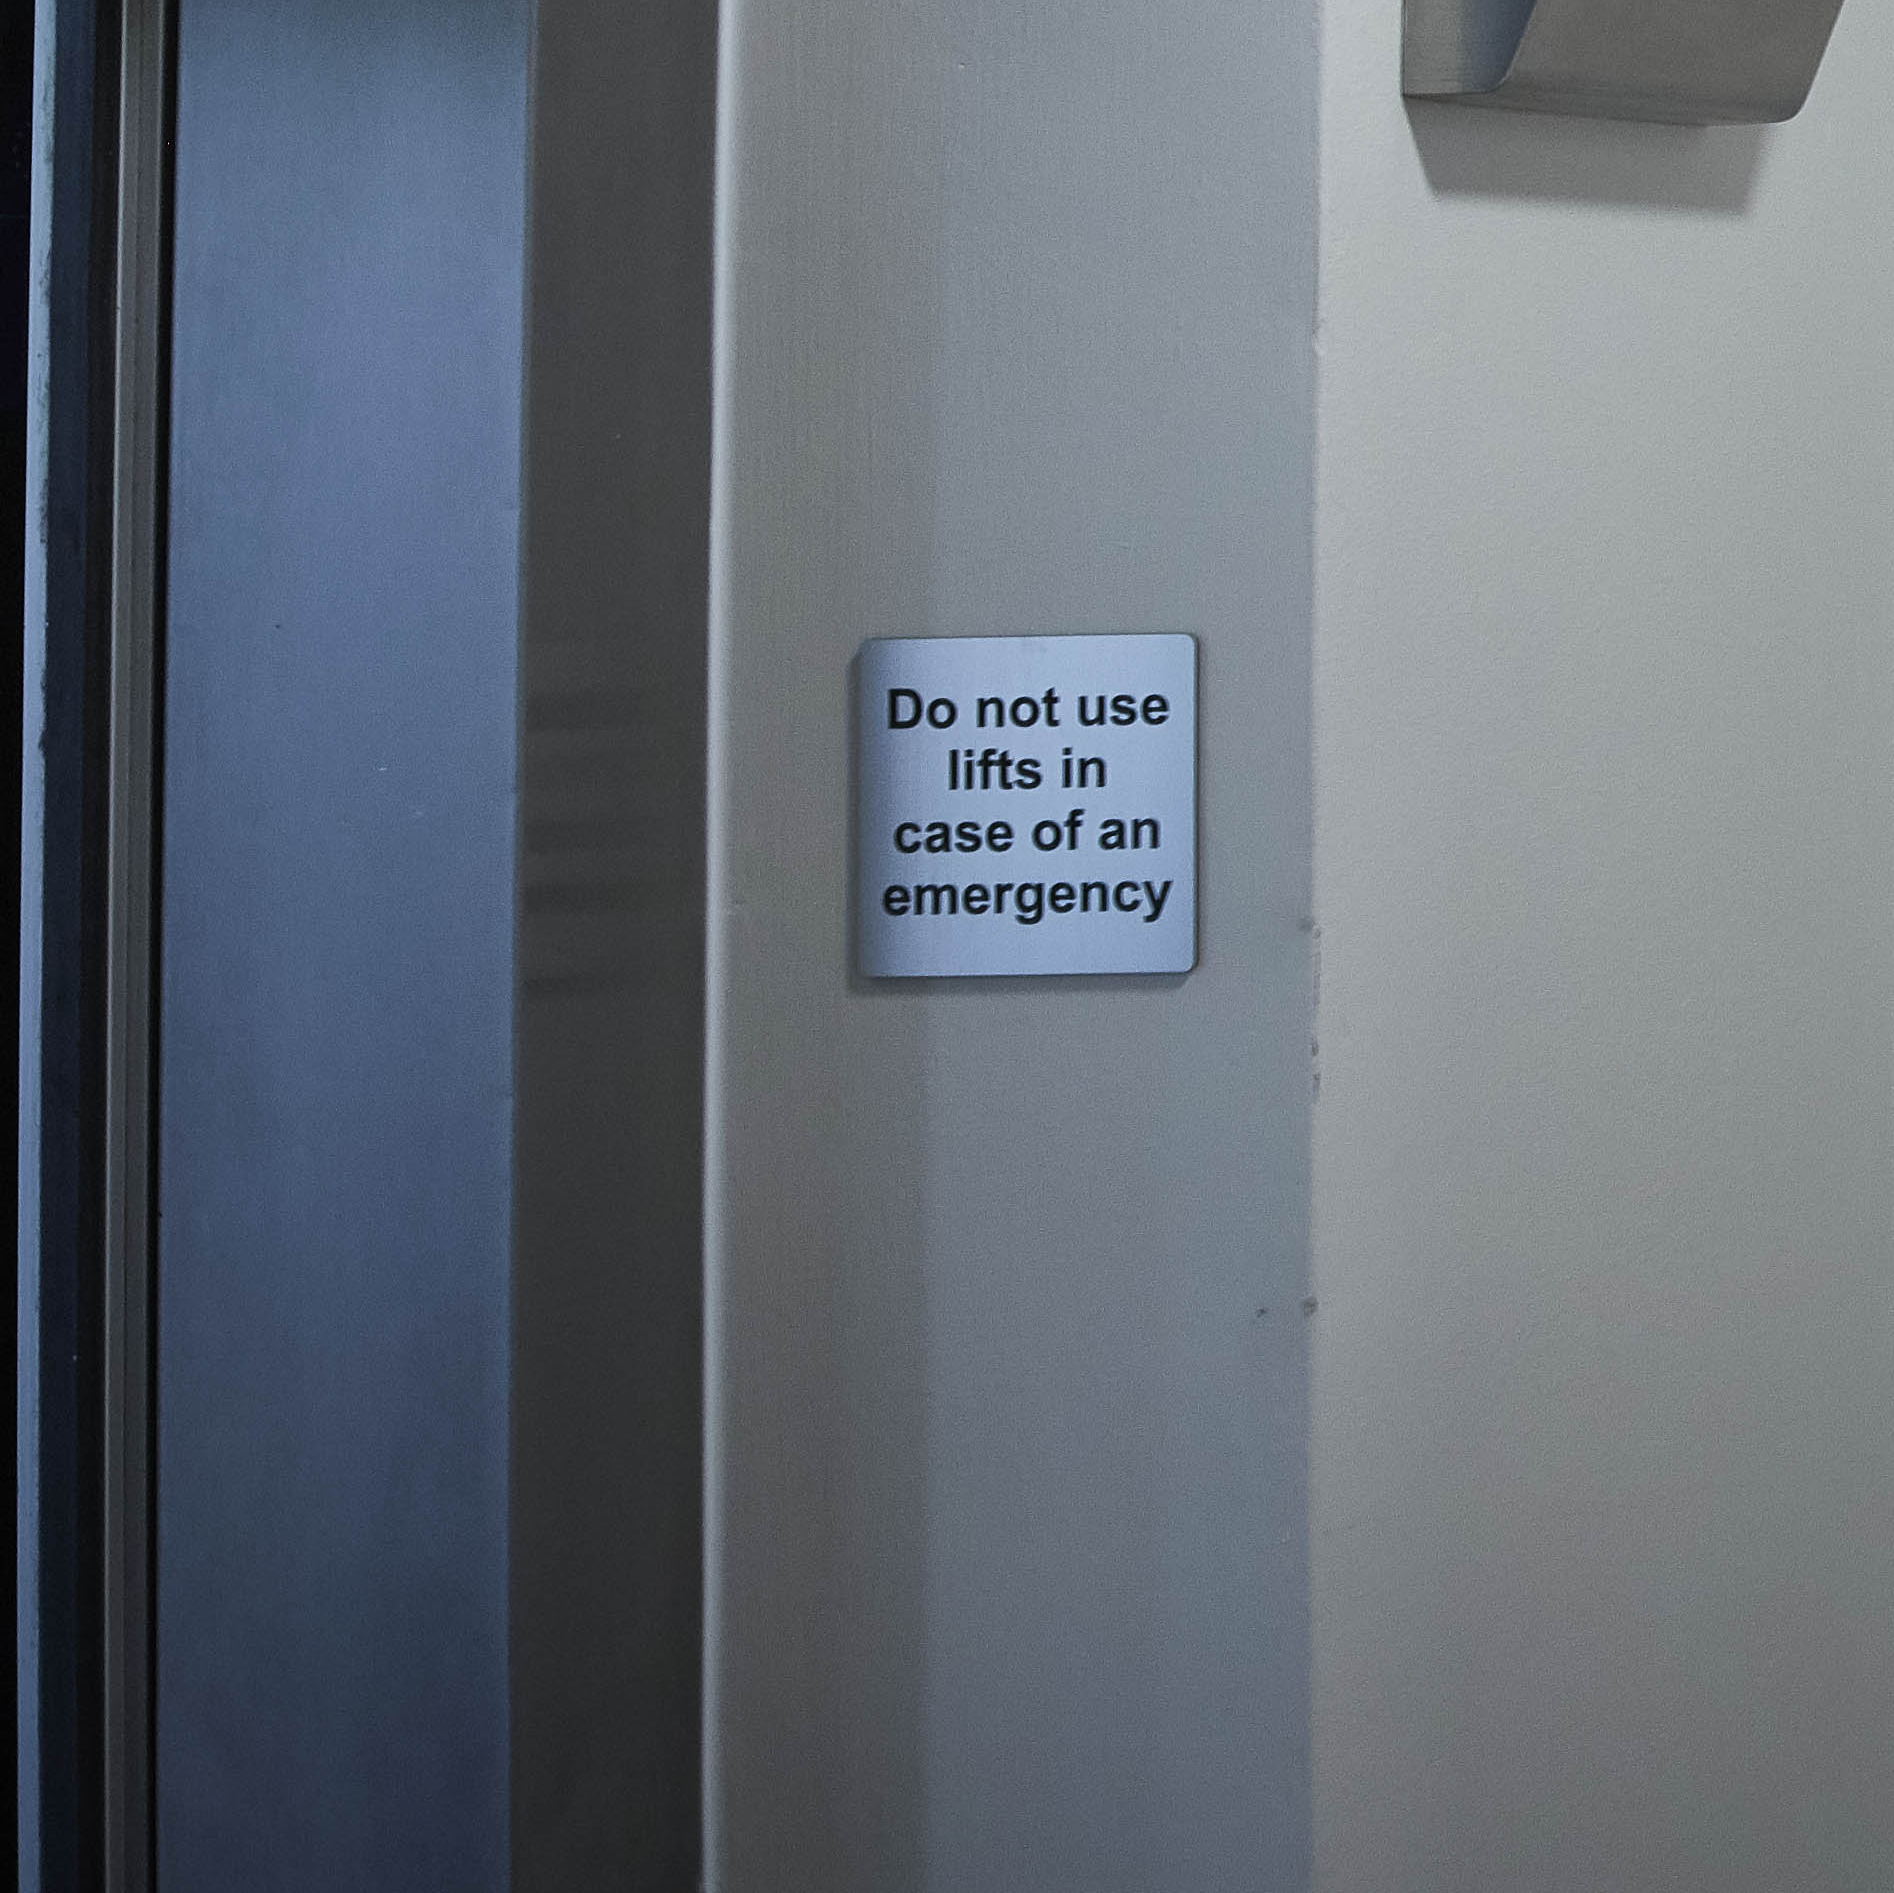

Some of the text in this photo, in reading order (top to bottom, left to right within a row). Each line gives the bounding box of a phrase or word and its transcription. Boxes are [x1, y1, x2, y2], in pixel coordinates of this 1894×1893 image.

[886, 687, 1170, 730] Do not use
[947, 747, 1107, 790] lifts in
[893, 808, 1161, 854] case of an
[881, 879, 1173, 925] emergency
